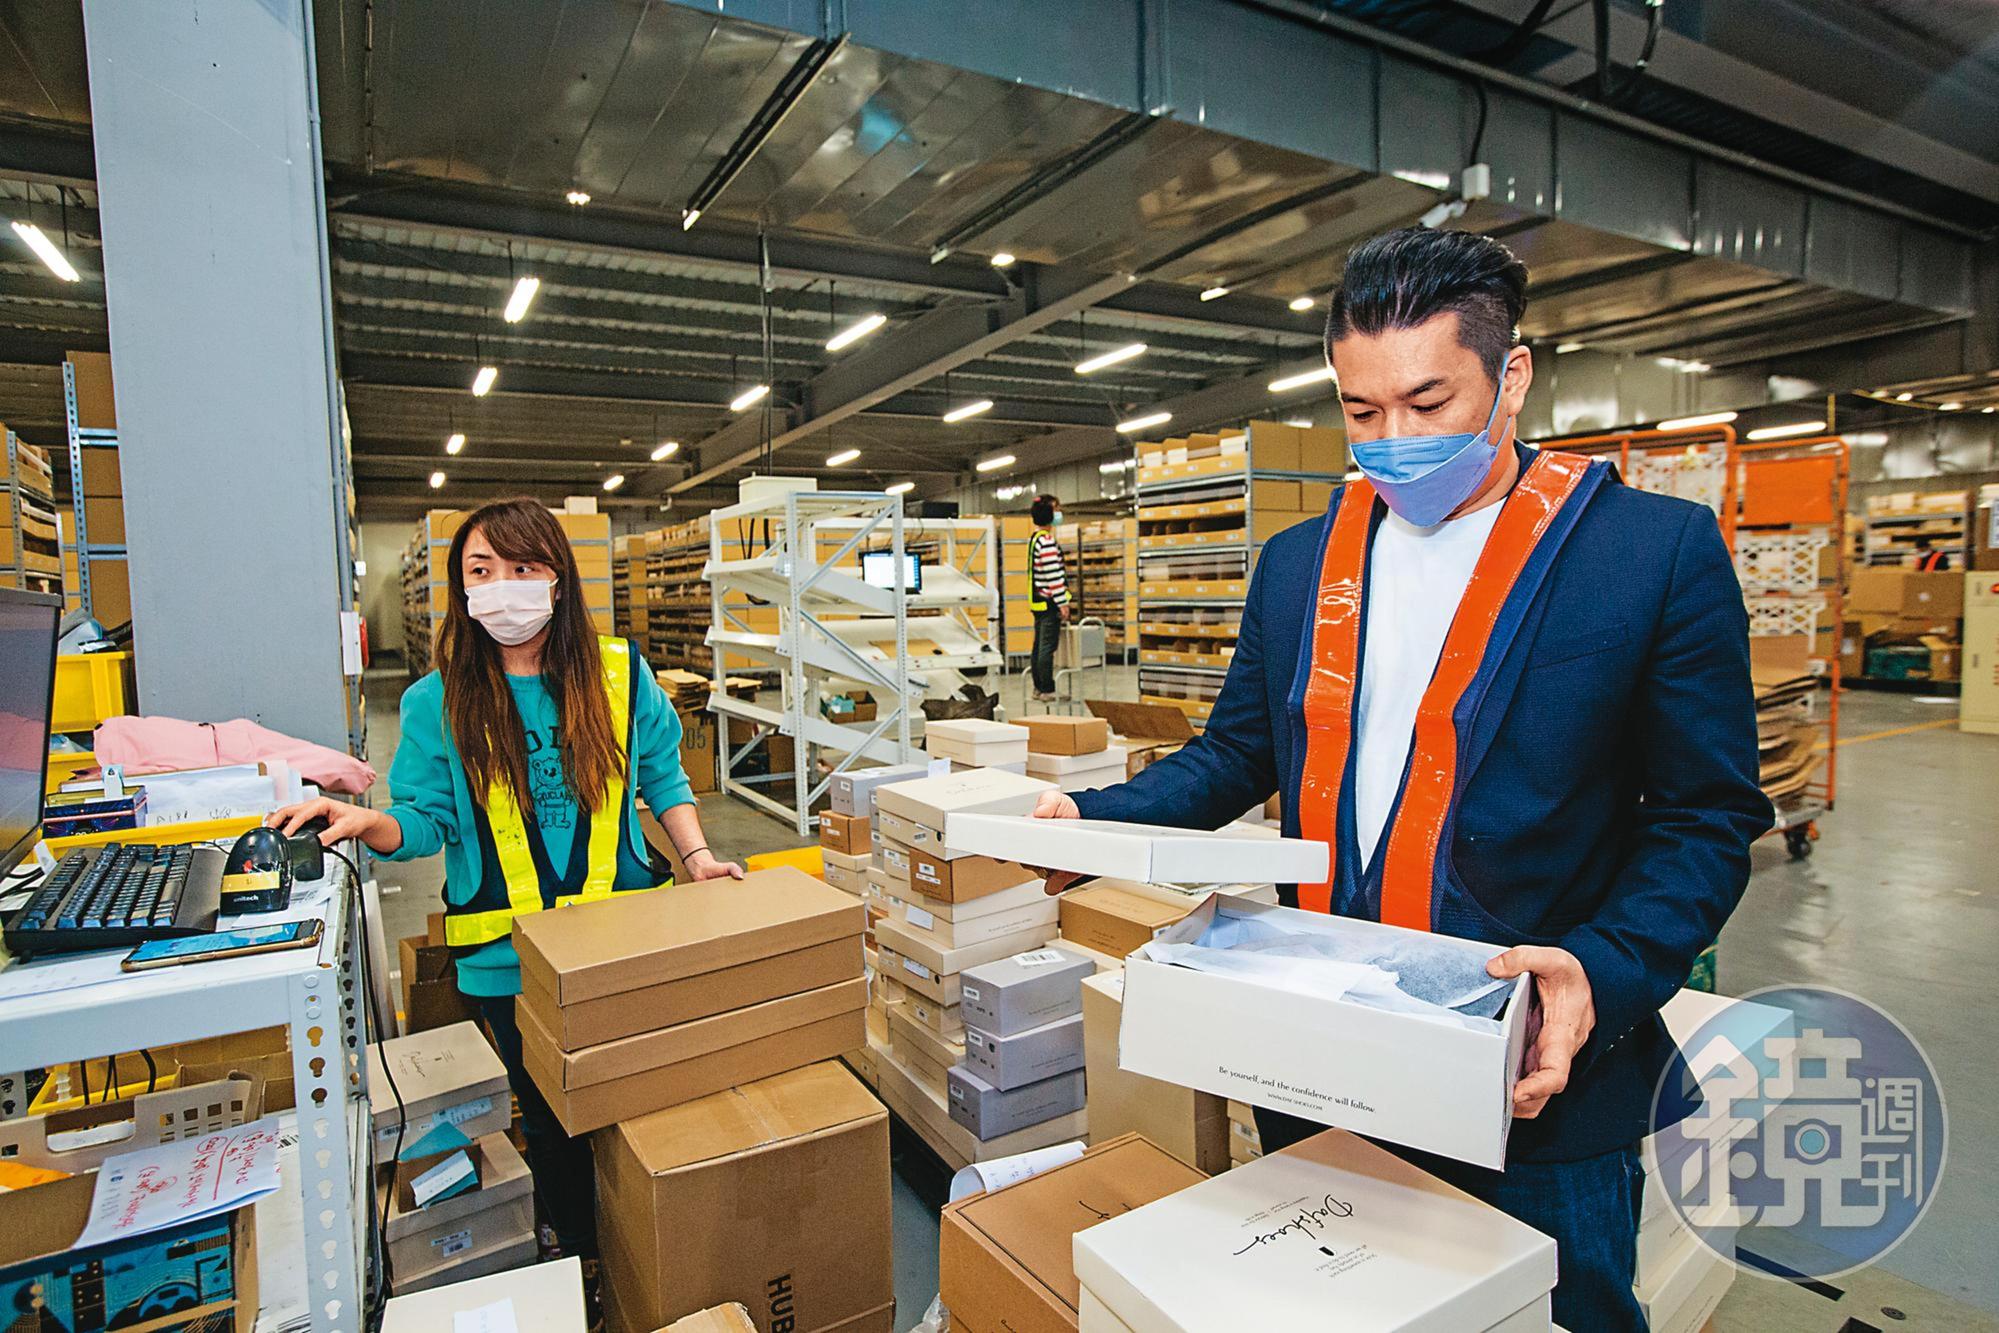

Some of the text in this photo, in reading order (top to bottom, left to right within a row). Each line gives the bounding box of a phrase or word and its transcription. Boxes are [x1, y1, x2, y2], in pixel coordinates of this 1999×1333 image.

[233, 894, 259, 903] unitech
[1218, 1065, 1377, 1114] Be yourself, and the confidence will follow.
